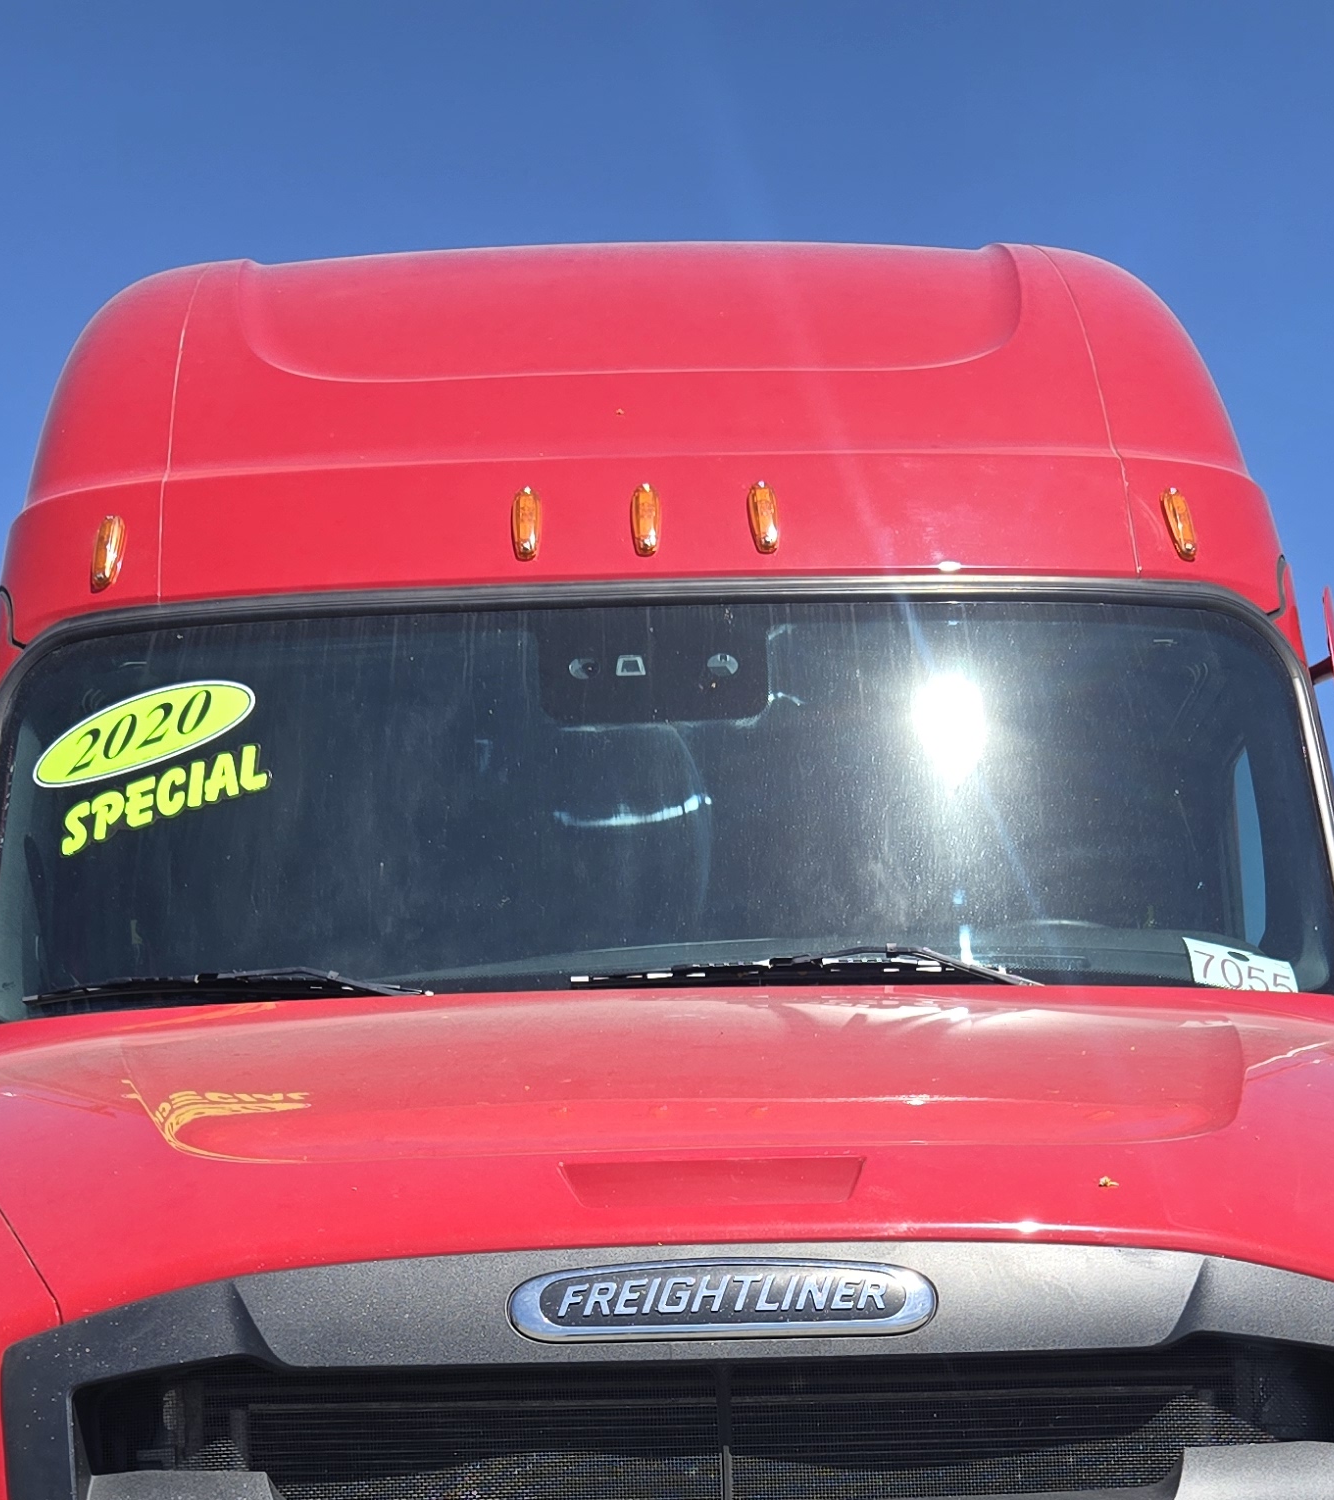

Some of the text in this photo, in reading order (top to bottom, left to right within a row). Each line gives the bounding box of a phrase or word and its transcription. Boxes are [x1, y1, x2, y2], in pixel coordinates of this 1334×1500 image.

[65, 689, 212, 777] 2020
[60, 744, 269, 856] SPECIAL
[1193, 950, 1293, 993] 7055
[557, 1274, 887, 1317] FREIGHTLINER
